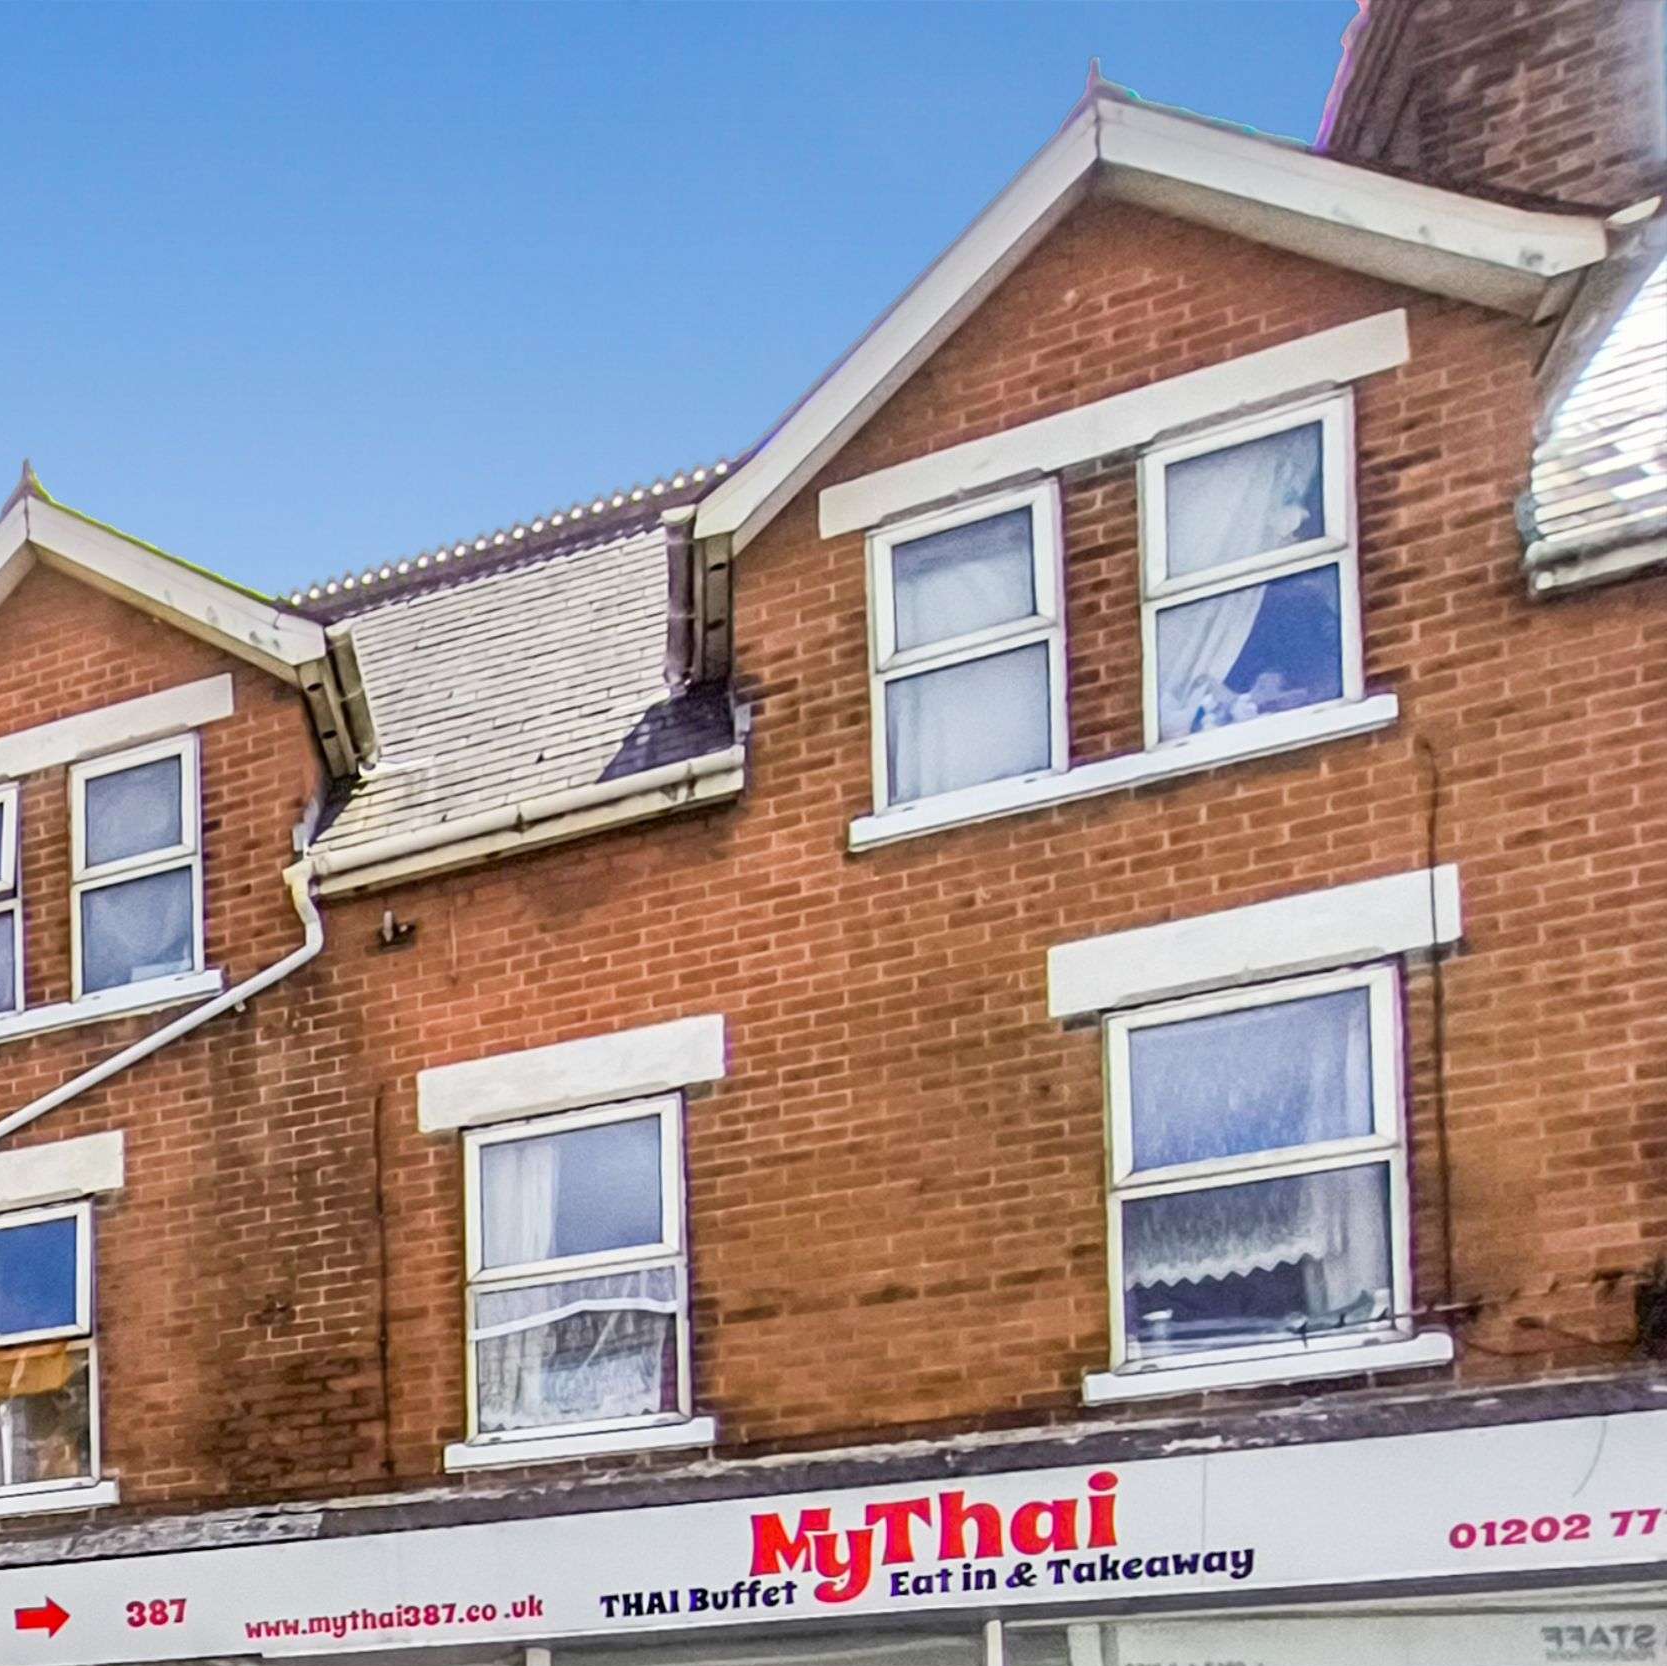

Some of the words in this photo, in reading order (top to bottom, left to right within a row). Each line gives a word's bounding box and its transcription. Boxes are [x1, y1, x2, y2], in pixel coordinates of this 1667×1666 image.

[749, 1471, 1119, 1604] MyThai
[1449, 1513, 1591, 1549] 01202
[1610, 1508, 1667, 1537] 77
[599, 1589, 680, 1618] THAI
[688, 1579, 797, 1612] Buffet
[890, 1567, 952, 1597] Eat
[962, 1563, 997, 1591] in
[1005, 1562, 1038, 1589] &
[1046, 1548, 1255, 1585] Takeaway
[126, 1598, 187, 1628] 387
